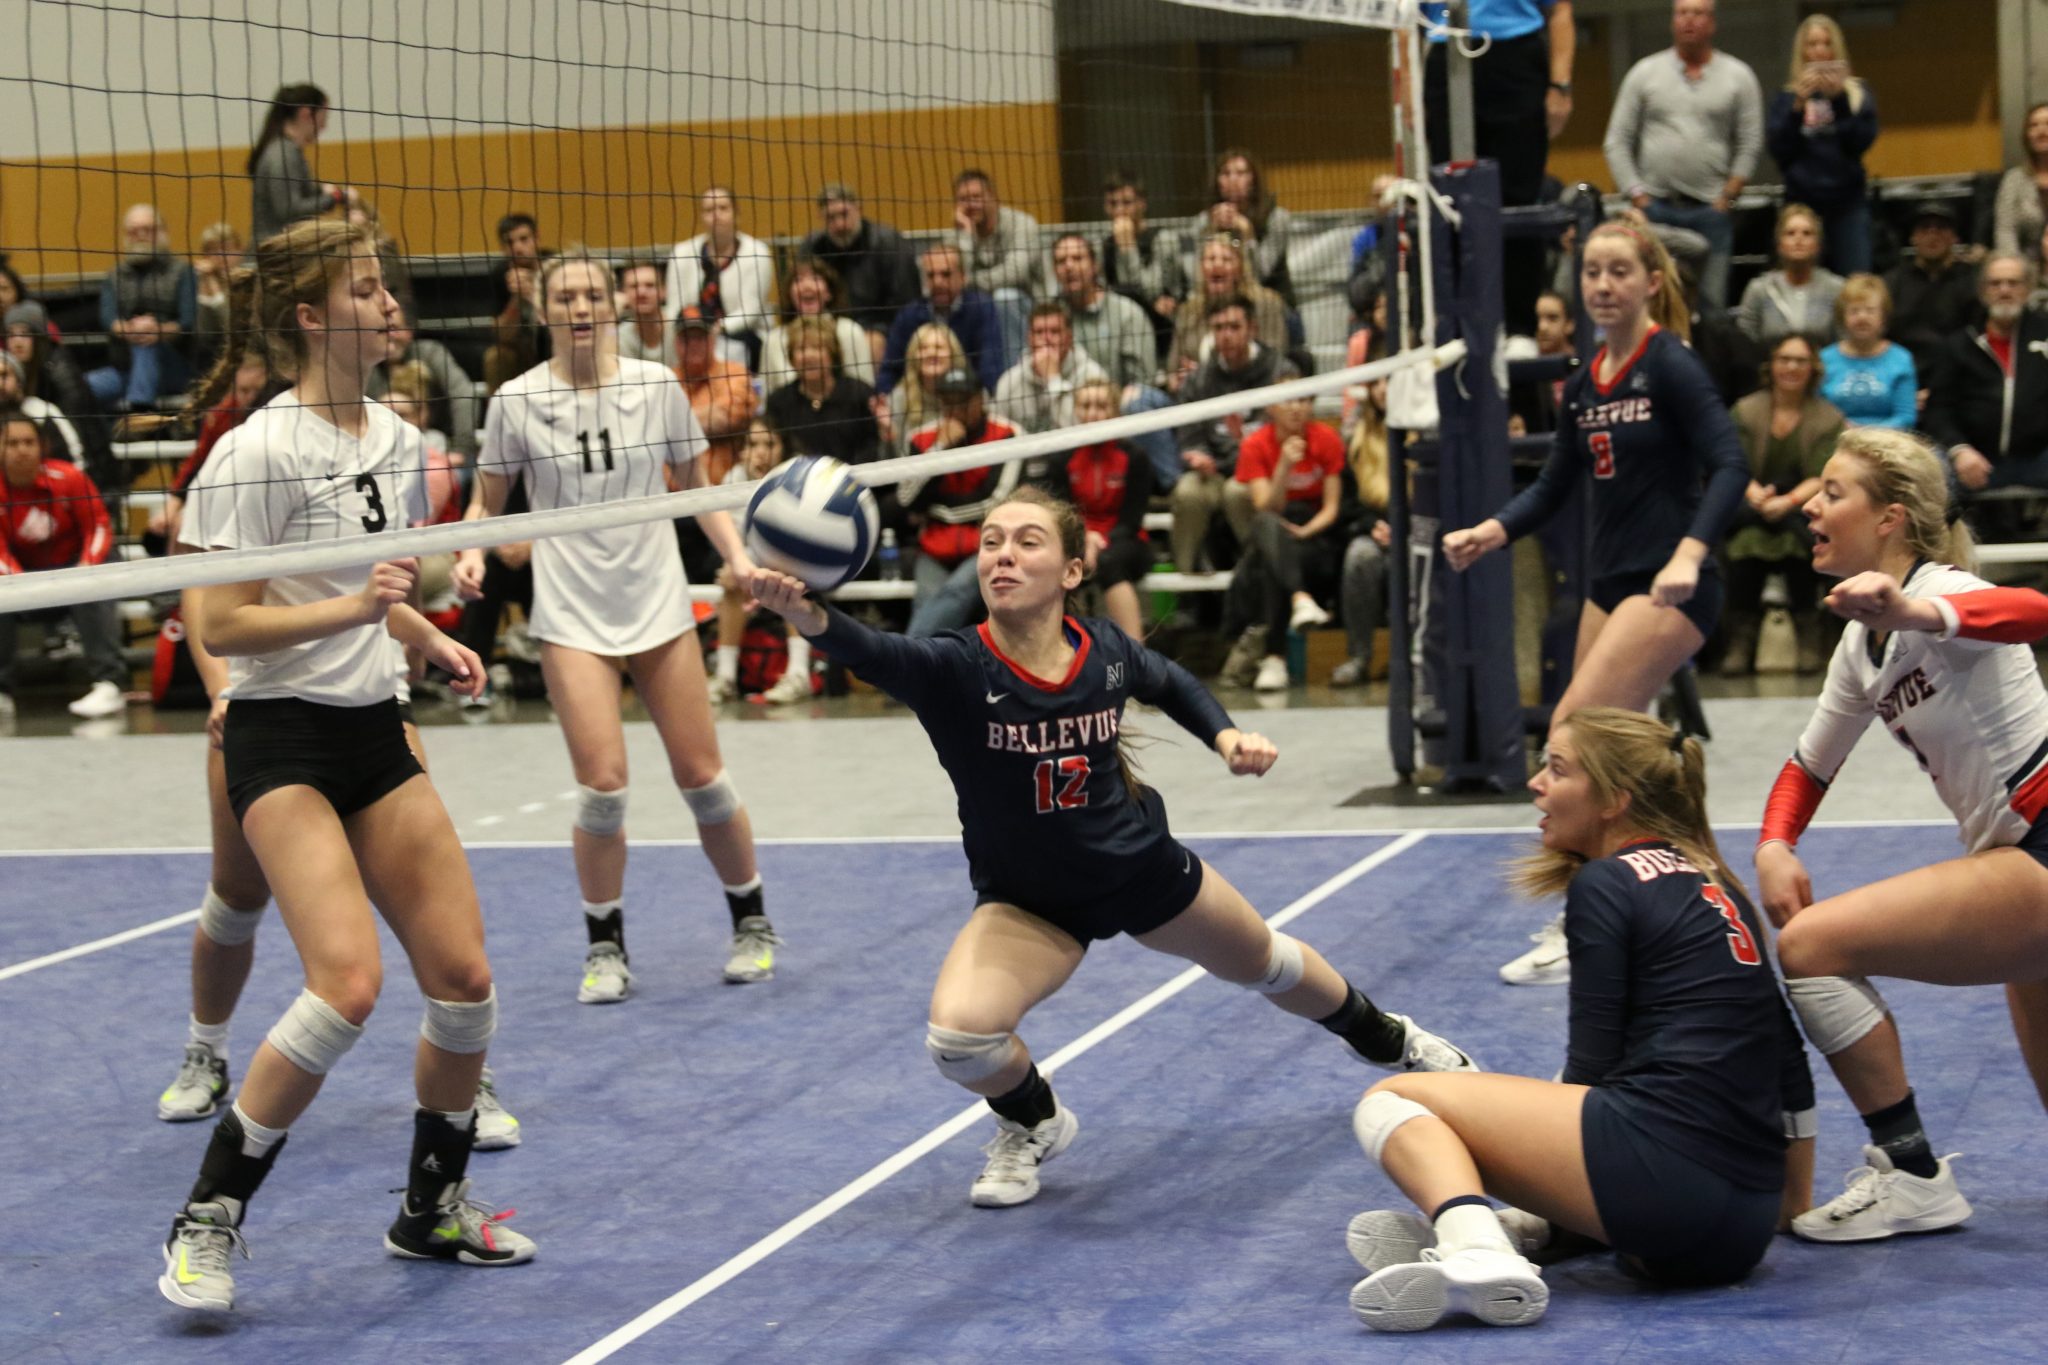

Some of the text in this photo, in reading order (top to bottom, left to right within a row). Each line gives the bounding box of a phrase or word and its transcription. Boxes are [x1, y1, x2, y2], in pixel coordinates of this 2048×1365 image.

[576, 428, 615, 473] 11
[1588, 431, 1615, 479] 8
[355, 472, 387, 533] 3
[1033, 755, 1091, 814] 12
[1701, 883, 1762, 965] 3
